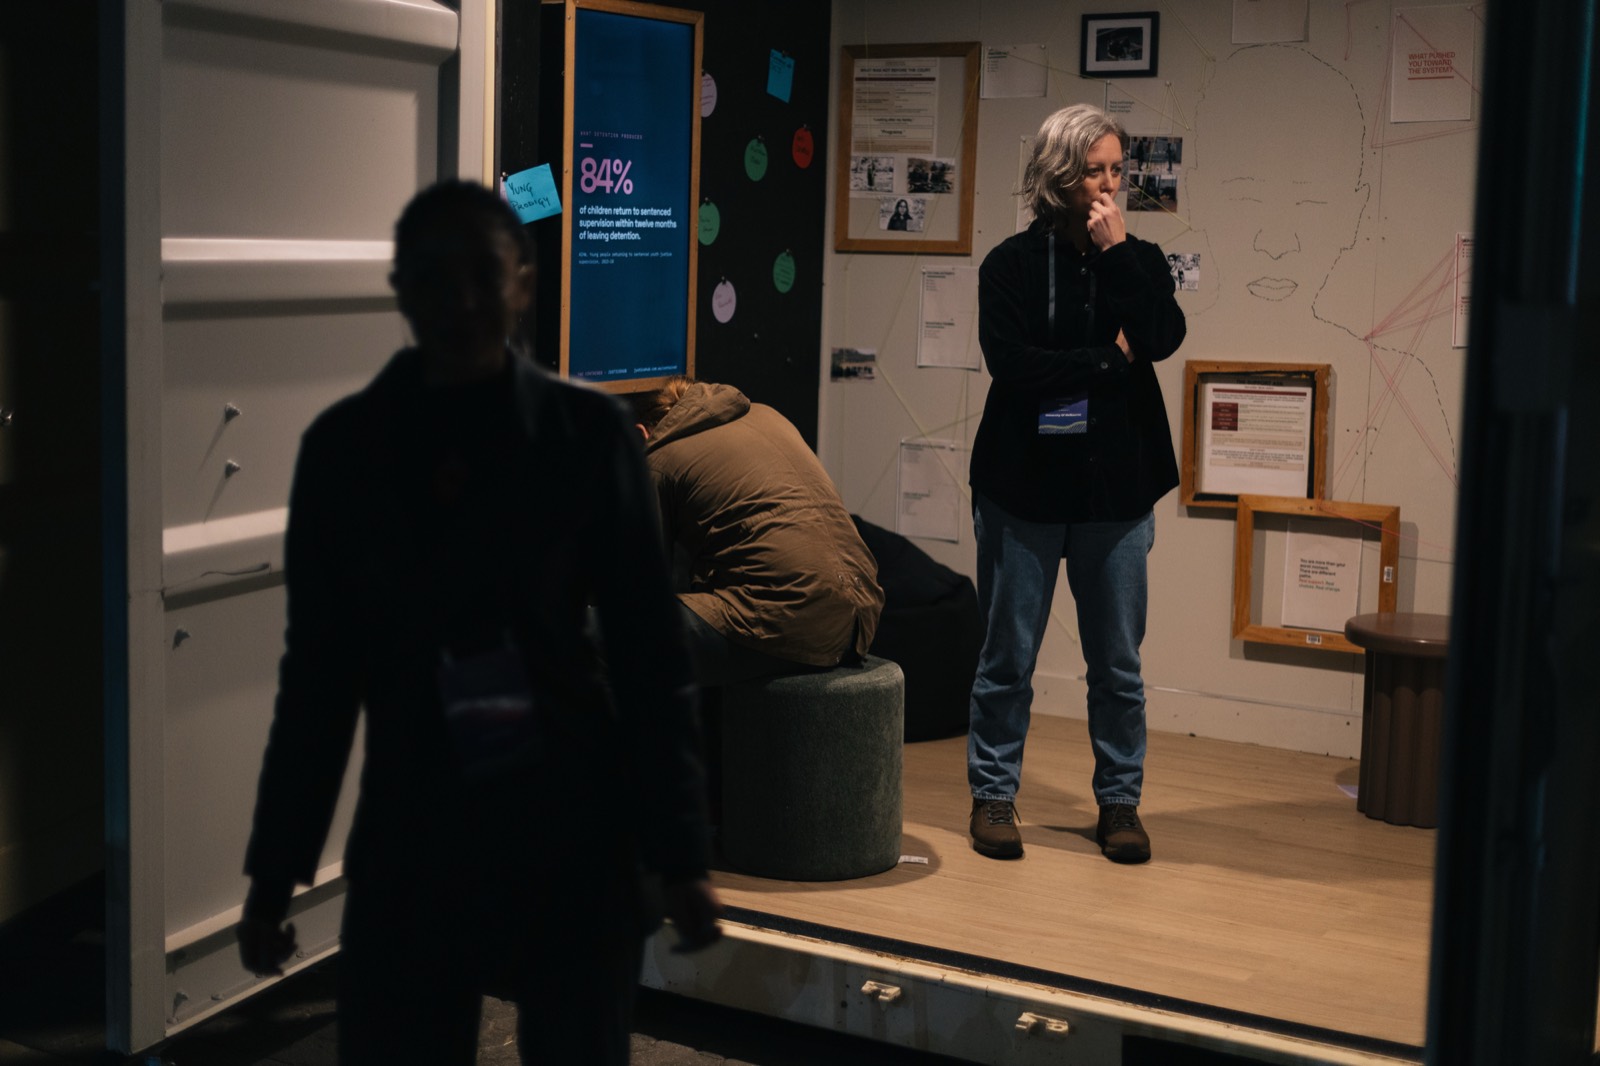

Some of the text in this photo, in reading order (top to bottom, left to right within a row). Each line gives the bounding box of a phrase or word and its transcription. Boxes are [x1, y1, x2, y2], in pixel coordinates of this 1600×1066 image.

[1428, 51, 1456, 59] PUSHED
[580, 157, 633, 195] 84%
[508, 182, 534, 197] YUNG
[579, 205, 672, 216] of children return to sentenced
[579, 218, 677, 229] supervision within twelve months
[579, 230, 641, 242] of leaving detention.
